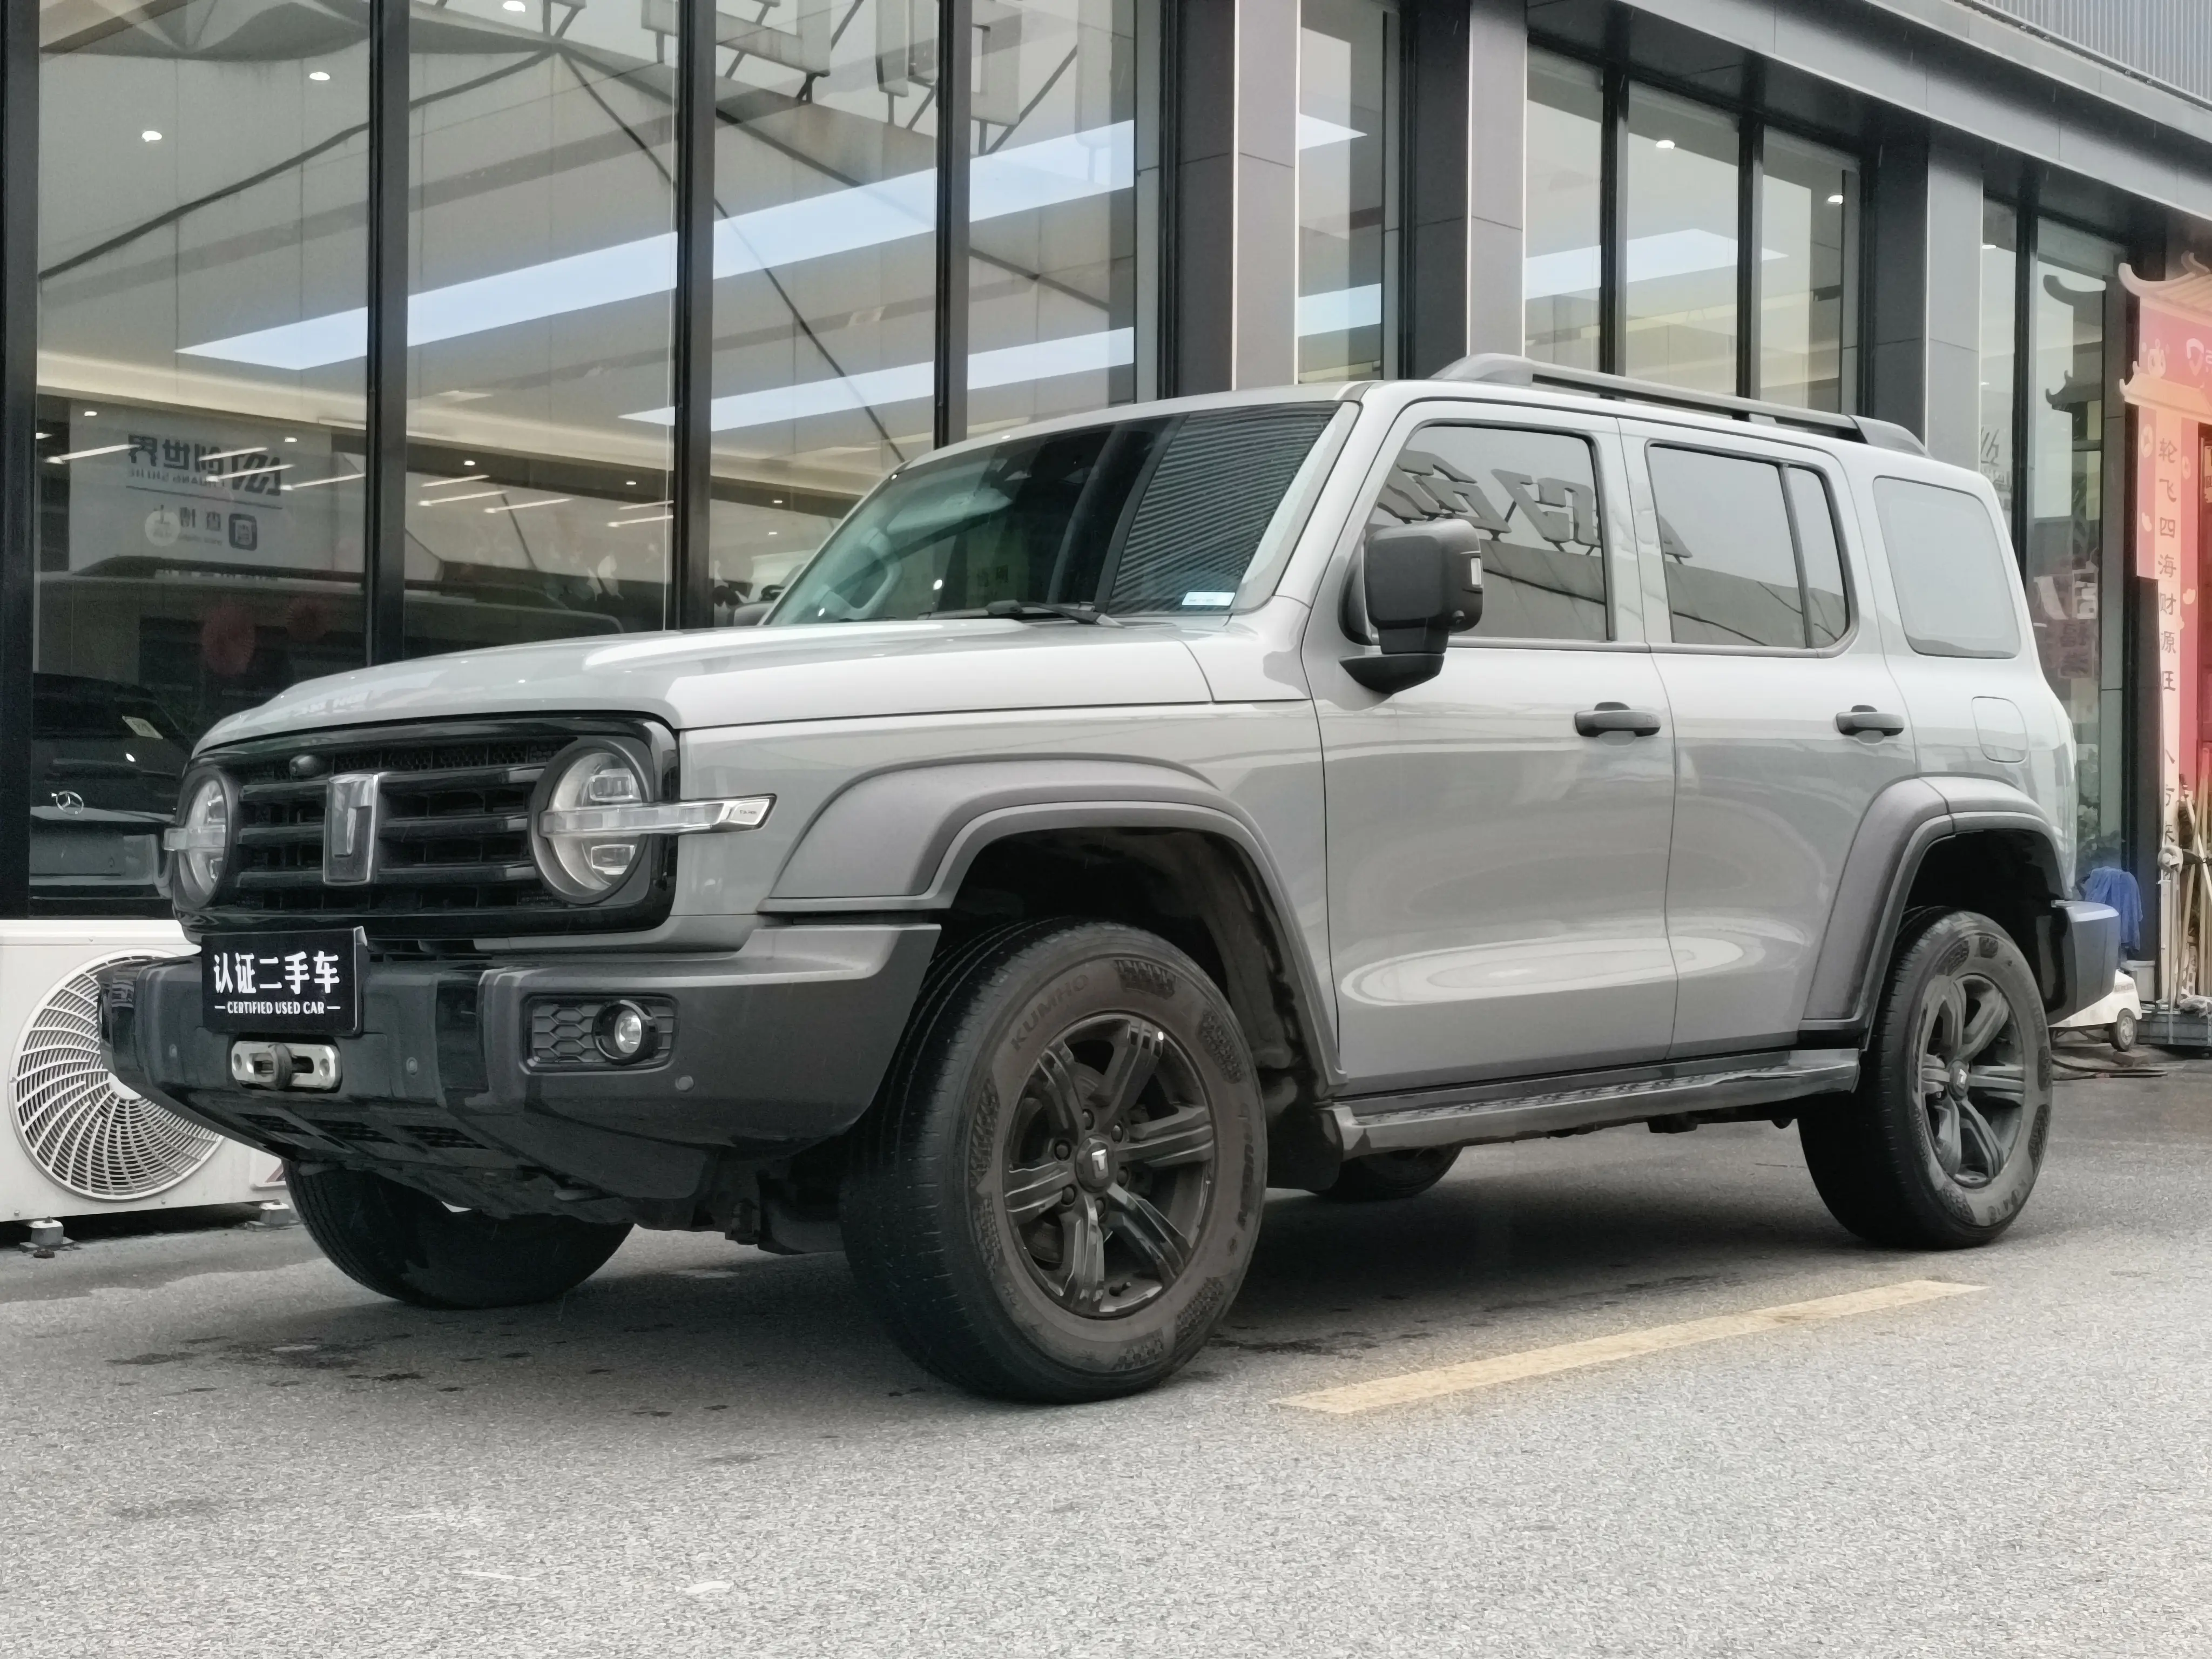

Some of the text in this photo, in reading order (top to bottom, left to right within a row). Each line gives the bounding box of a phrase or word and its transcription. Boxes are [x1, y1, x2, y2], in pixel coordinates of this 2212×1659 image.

[213, 950, 340, 994] 认证二手车
[227, 1001, 325, 1014] CERTIFIED USED CAR
[1010, 975, 1089, 1051] KUMHO
